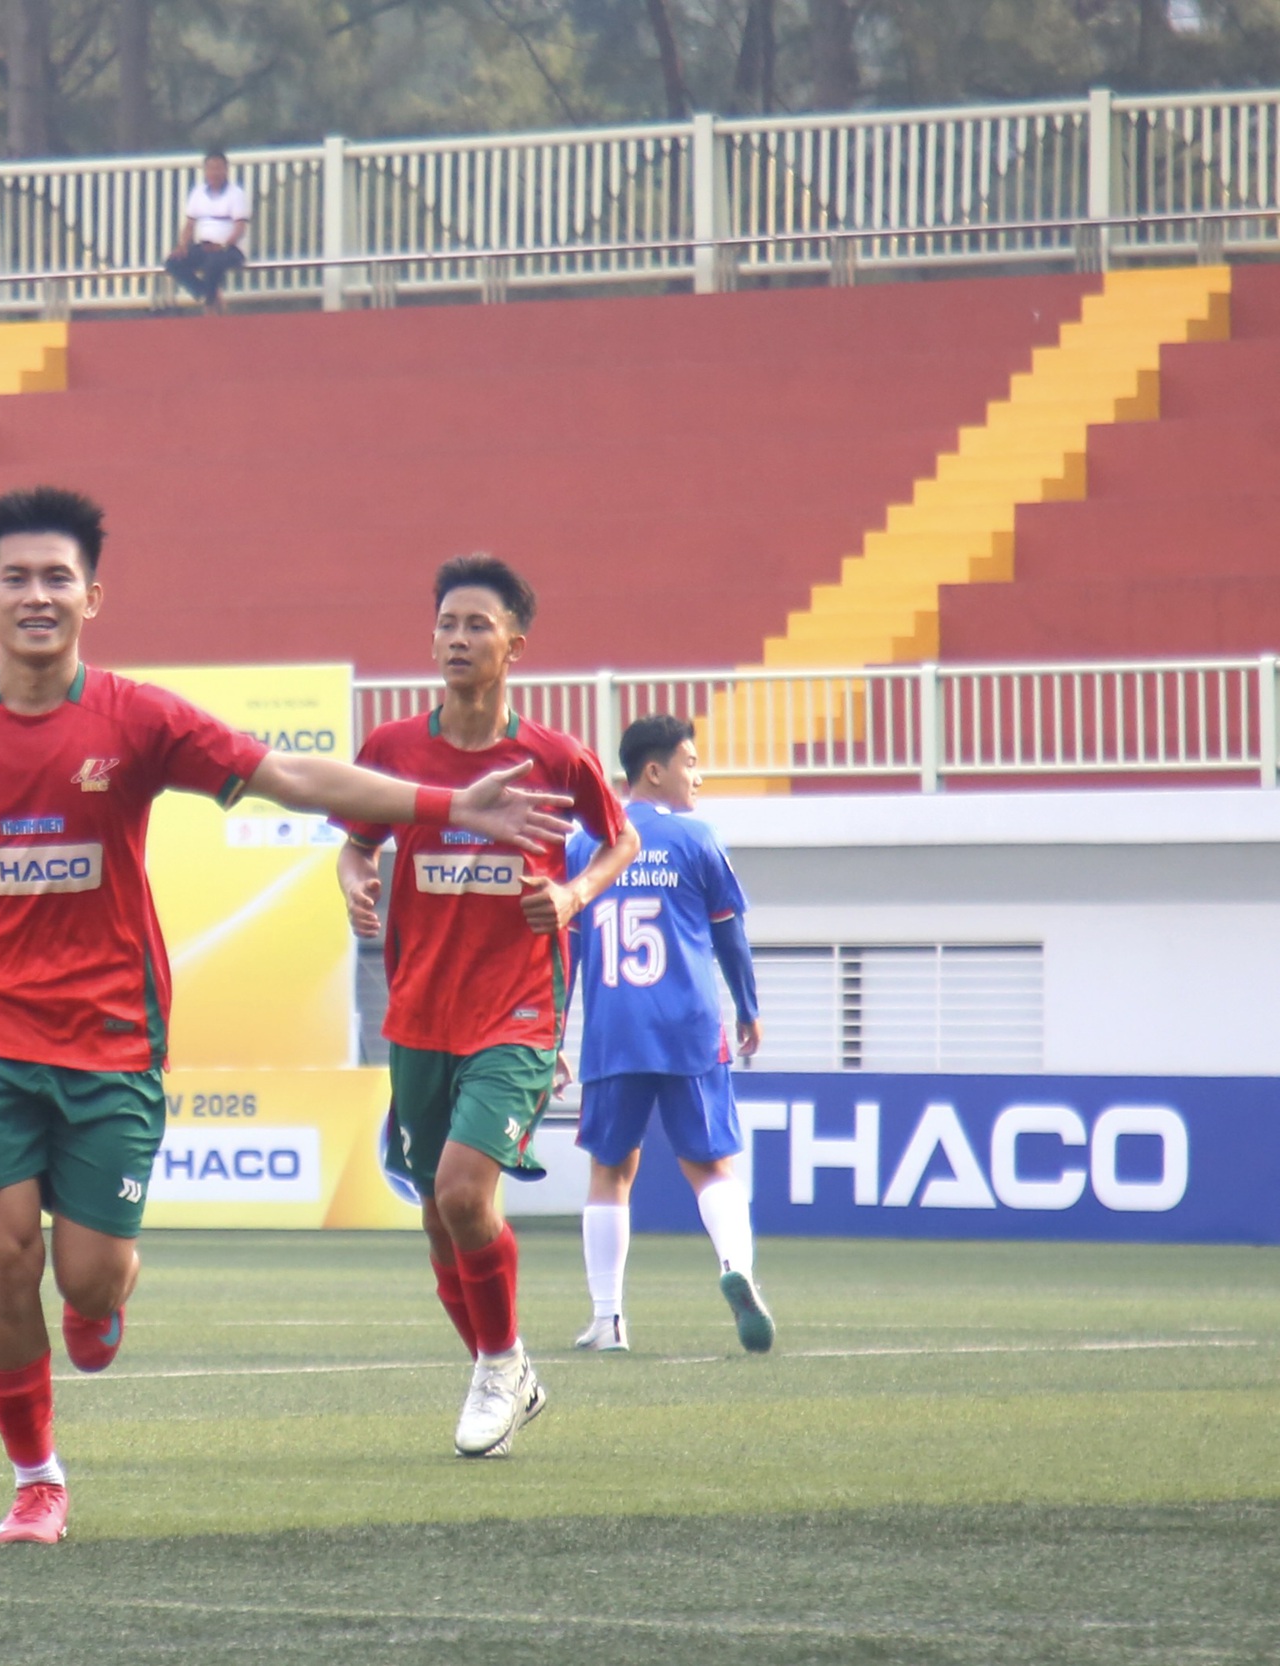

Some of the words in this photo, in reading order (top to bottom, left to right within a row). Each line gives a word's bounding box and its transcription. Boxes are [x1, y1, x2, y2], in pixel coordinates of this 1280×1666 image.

[648, 851, 669, 867] HỌC
[422, 865, 513, 885] THACO
[631, 867, 651, 887] SÀI
[651, 867, 678, 888] GÒN
[593, 898, 667, 988] 15
[193, 1094, 257, 1117] 2026
